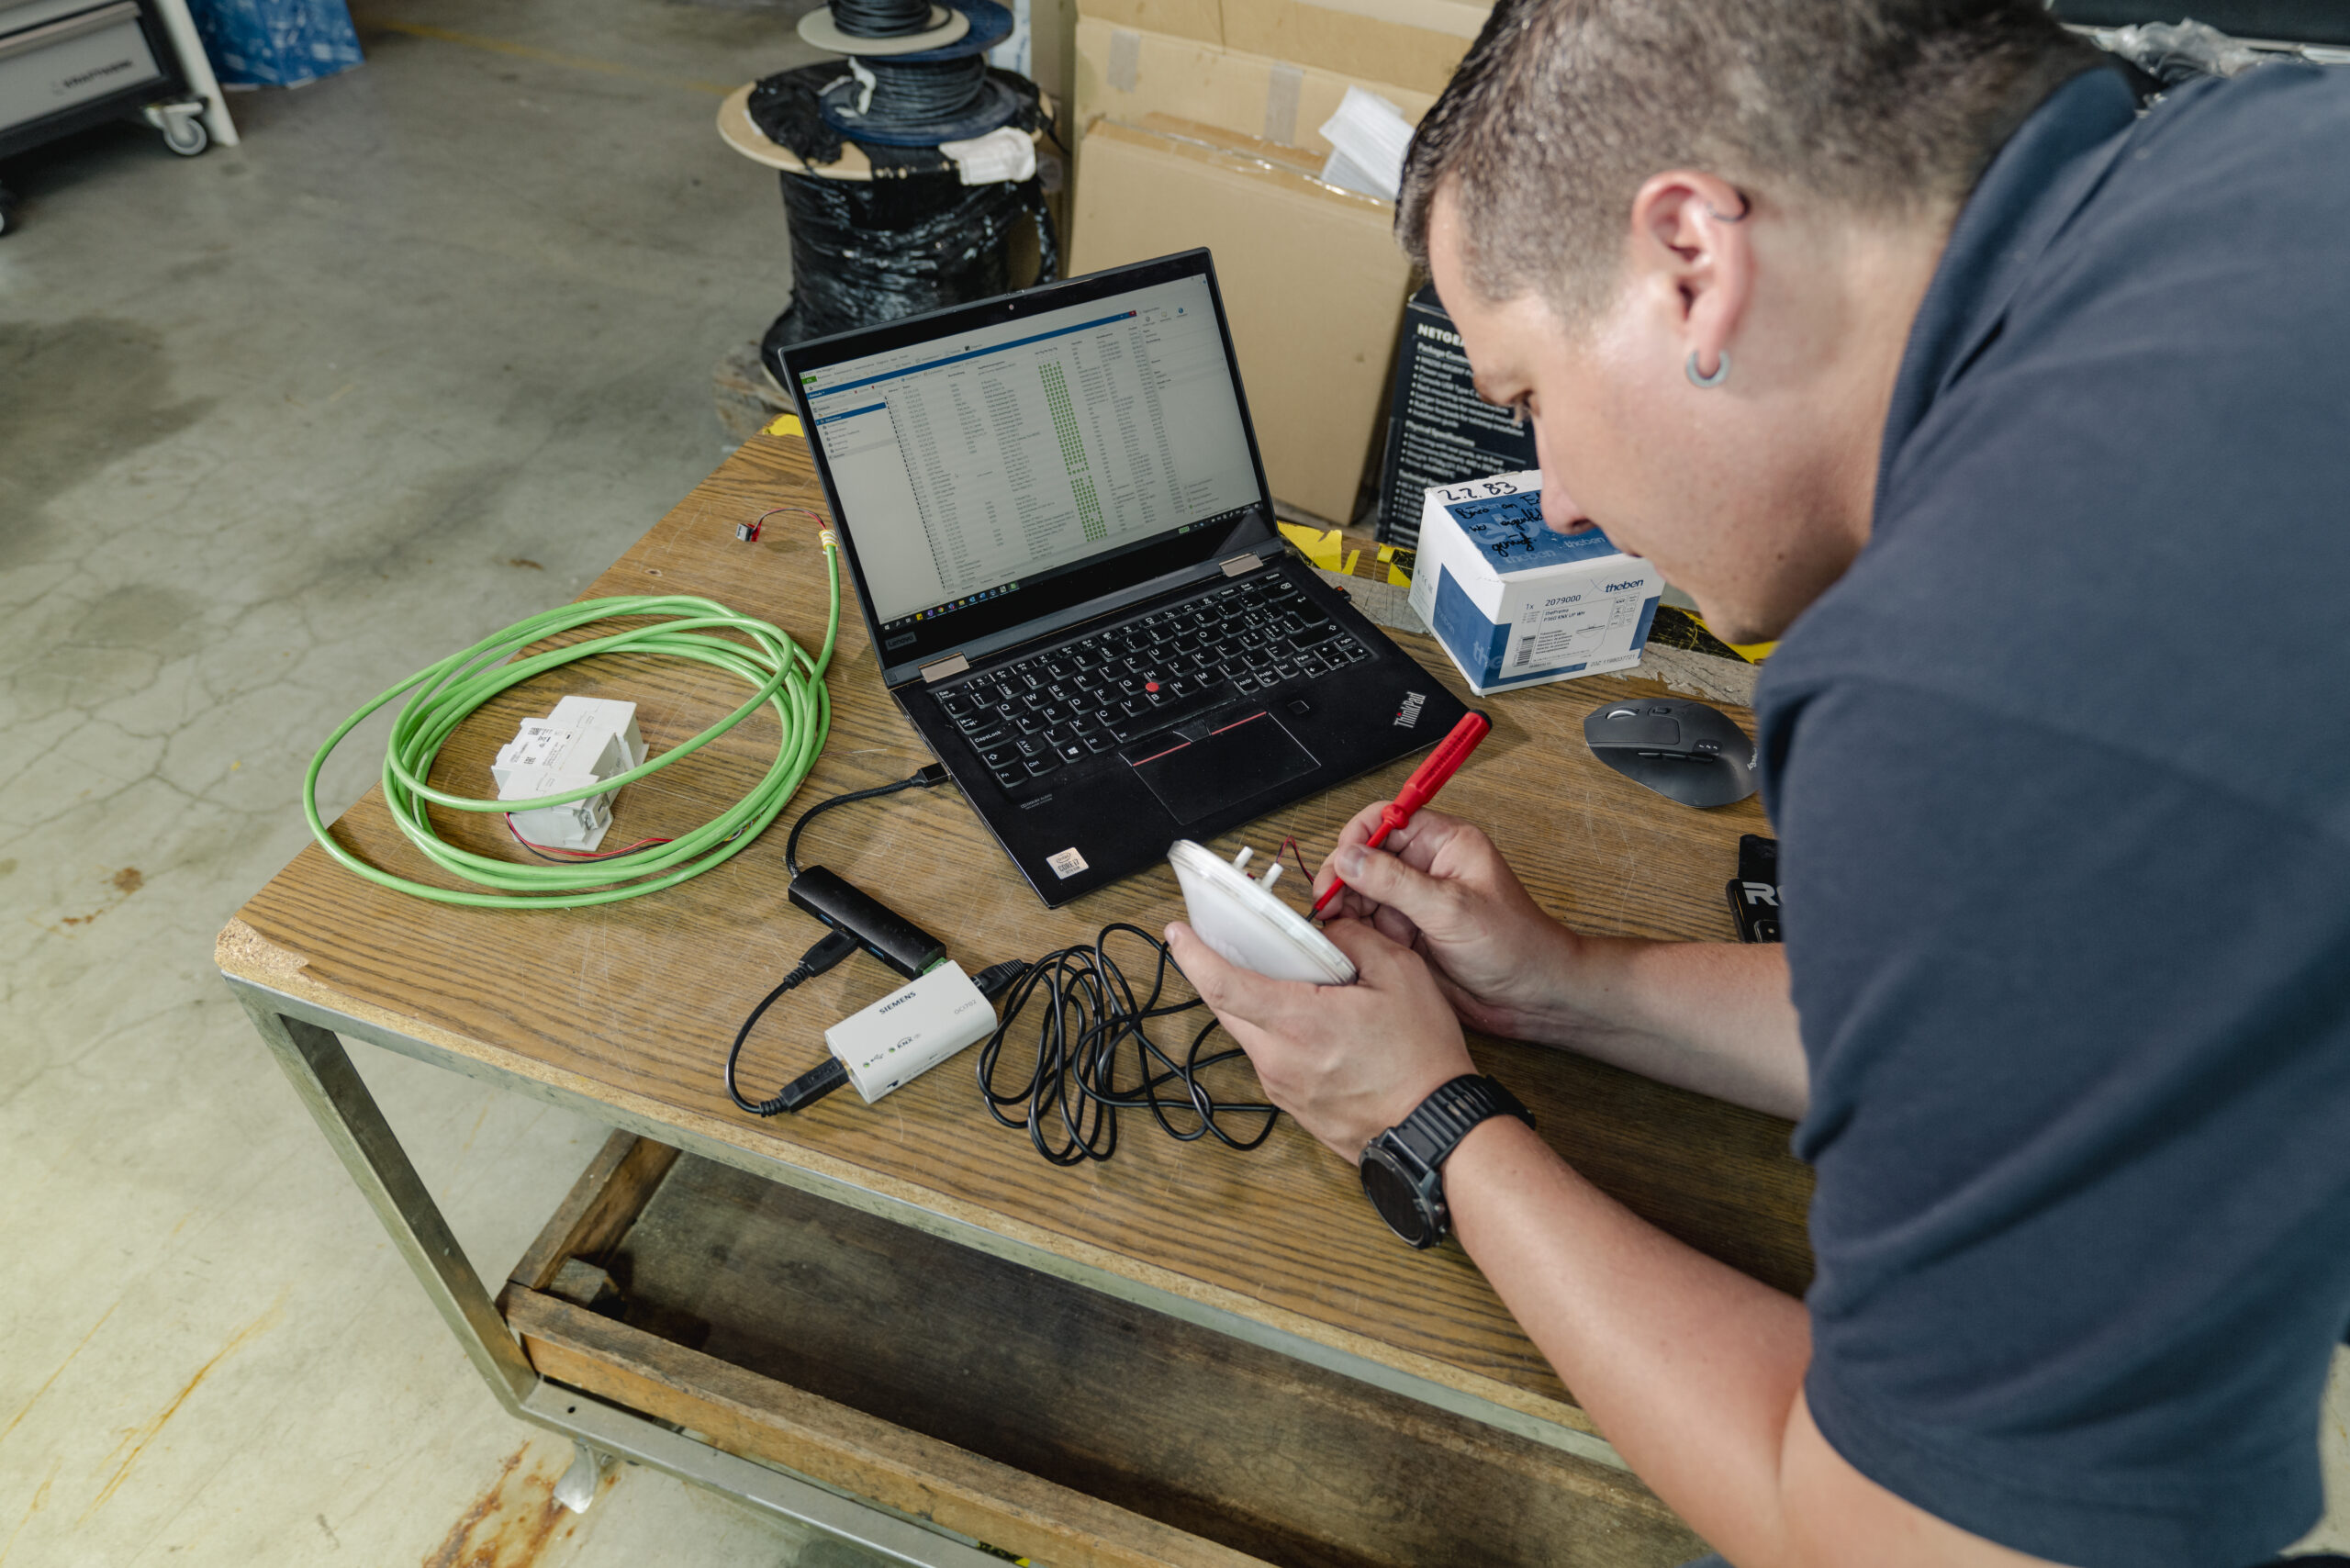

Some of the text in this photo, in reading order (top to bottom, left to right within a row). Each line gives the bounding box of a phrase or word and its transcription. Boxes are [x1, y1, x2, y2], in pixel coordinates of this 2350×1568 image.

[1606, 579, 1644, 593] theben
[1545, 594, 1581, 607] 2079000
[1393, 691, 1427, 728] ThinkPad
[974, 730, 1002, 743] CapsLock
[1058, 861, 1073, 872] CORE
[878, 991, 916, 1014] SIEMENS
[954, 999, 977, 1014] OCI702
[897, 1036, 913, 1049] KNX
